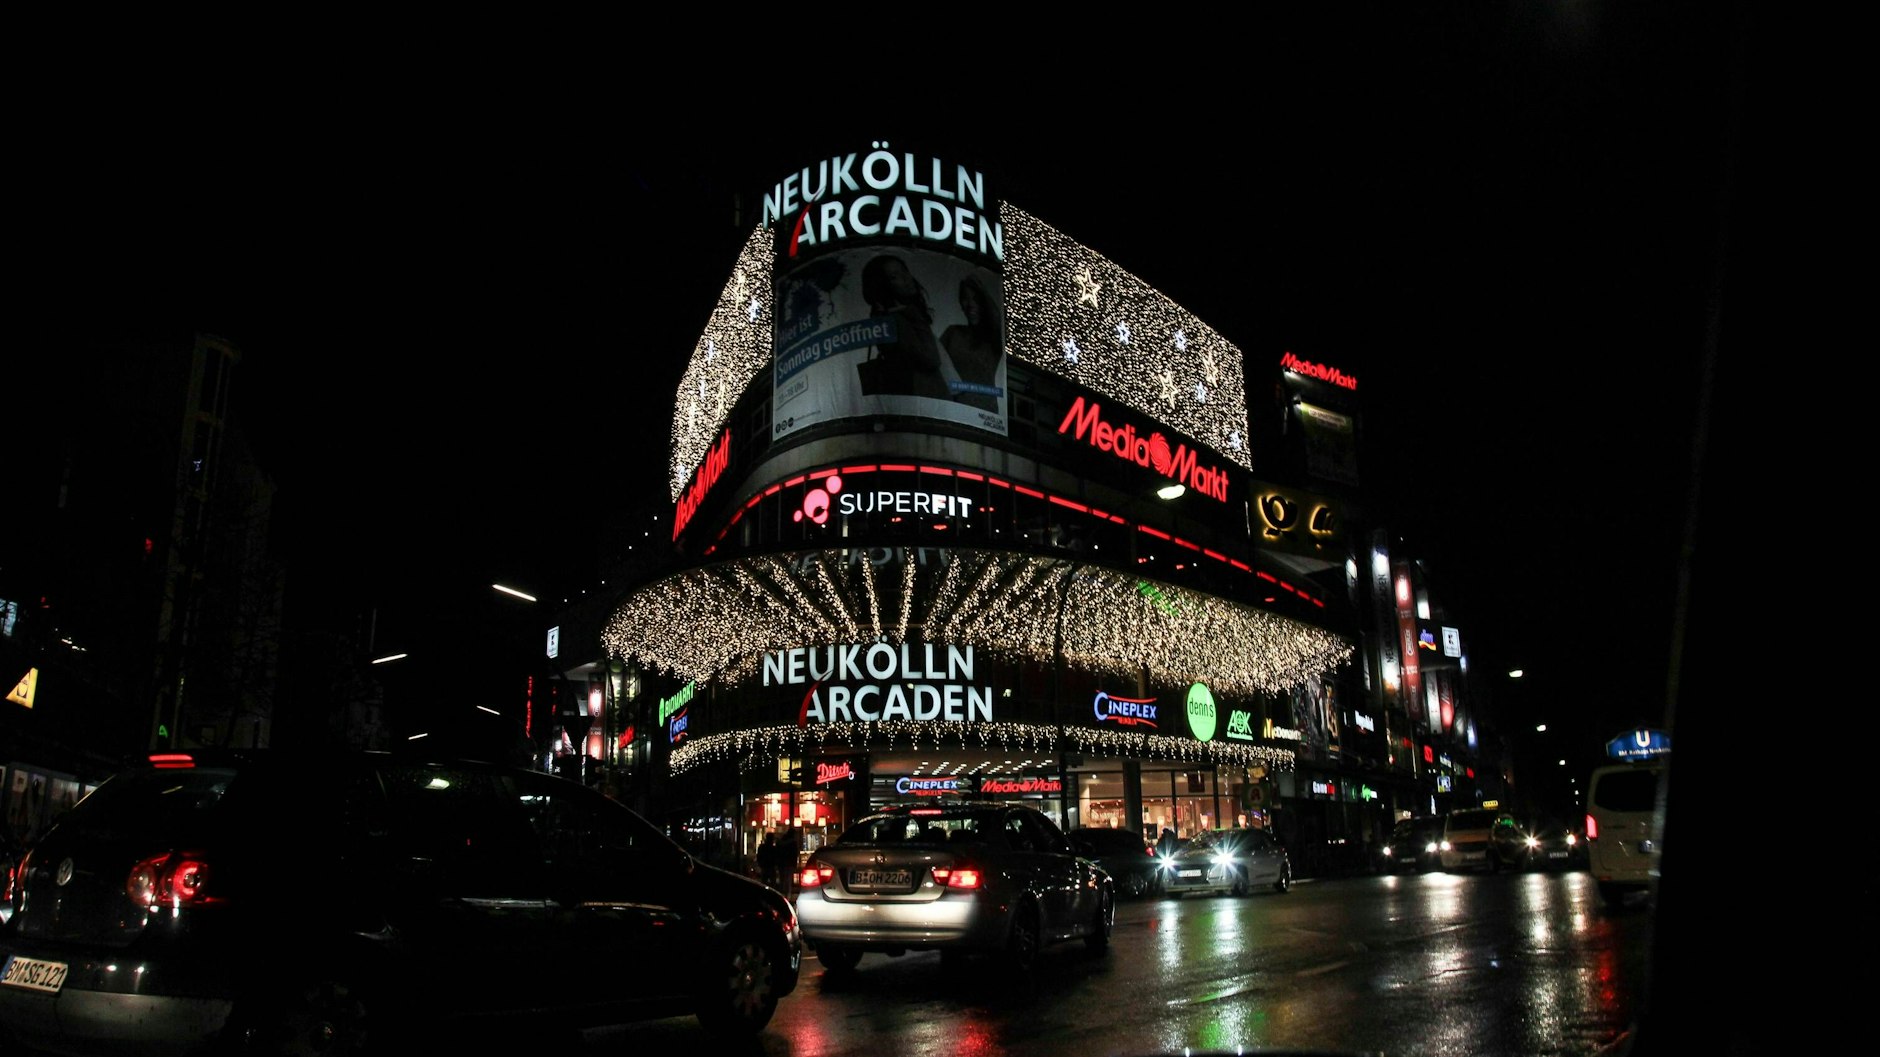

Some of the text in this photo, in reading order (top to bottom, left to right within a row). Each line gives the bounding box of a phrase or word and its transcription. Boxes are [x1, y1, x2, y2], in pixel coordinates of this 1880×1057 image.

[762, 140, 985, 231] NEUKÖLLN
[789, 194, 1004, 261] ARCADEN
[778, 314, 812, 348] Hier ist
[778, 322, 890, 379] Sonntag geöffnet
[1280, 350, 1359, 391] Media Markt
[1058, 396, 1230, 503] Media Markt
[839, 491, 973, 518] SUPERFIT
[762, 635, 975, 687] NEUKÖLLN
[665, 680, 695, 717] BIOMARKT
[797, 682, 994, 728] ARCADEN
[1094, 691, 1157, 721] CINEPLEX
[1227, 710, 1253, 733] AOK
[1635, 729, 1651, 748] U
[816, 762, 850, 784] Ditsch
[896, 776, 958, 794] CINEPLEX
[981, 780, 1021, 793] Media
[884, 871, 911, 885] 2206
